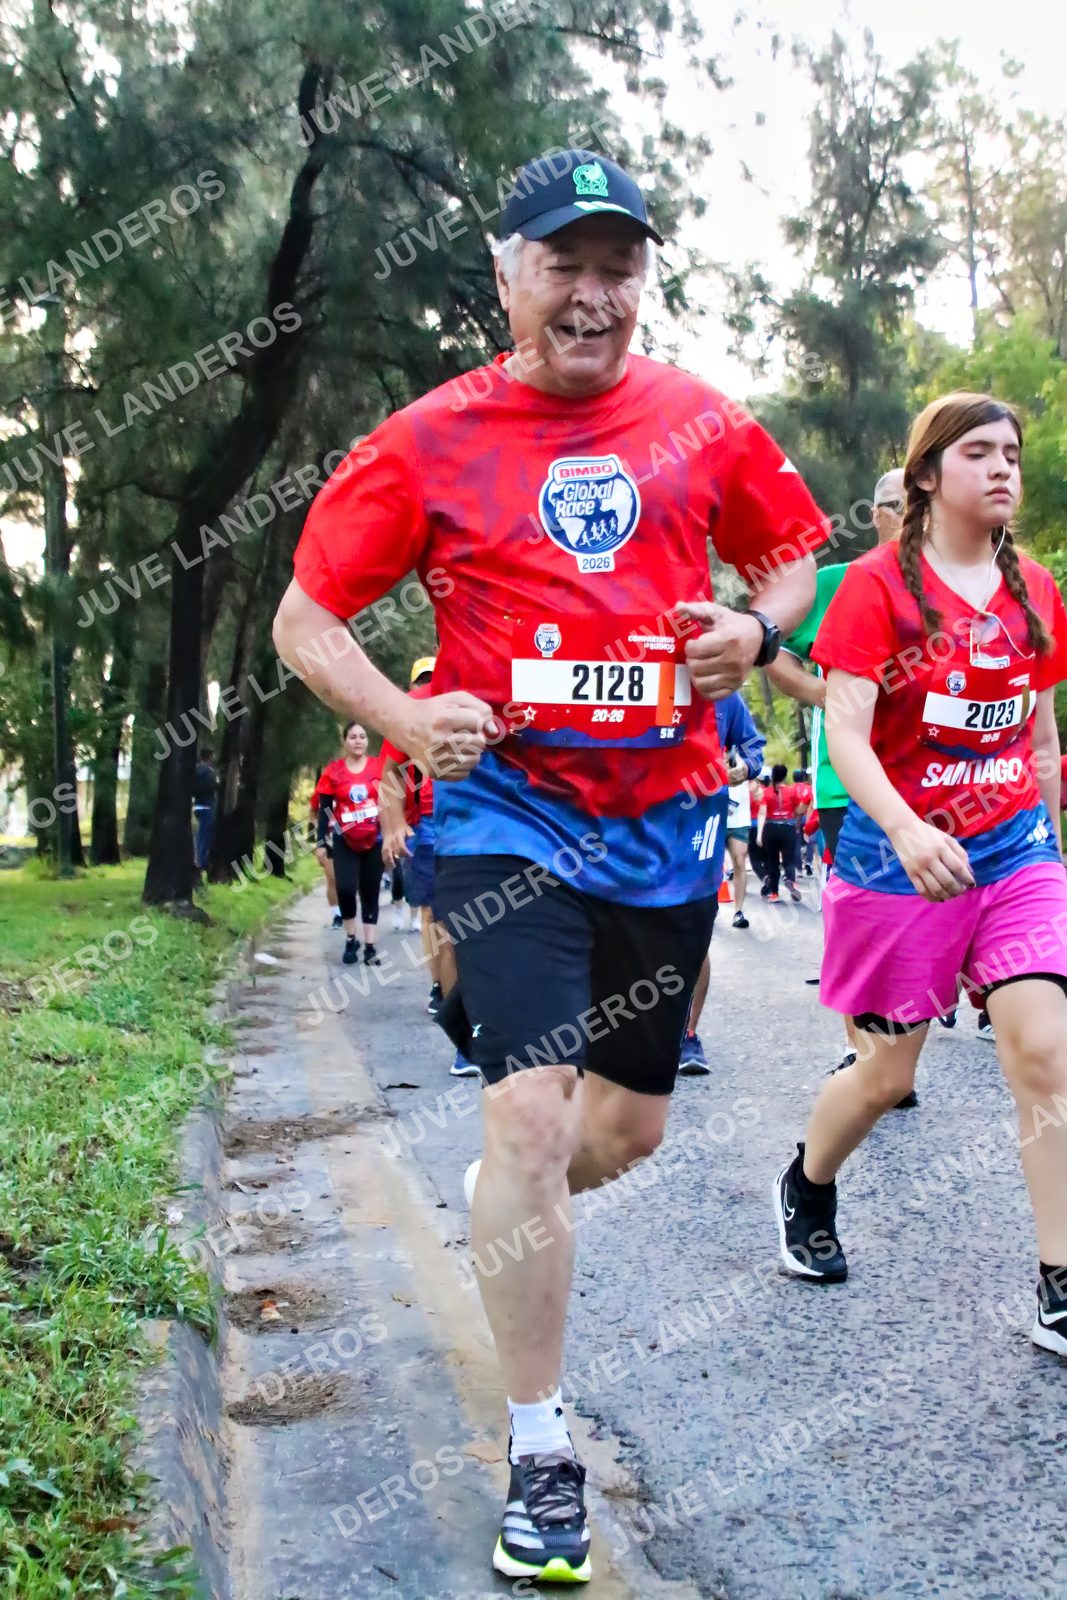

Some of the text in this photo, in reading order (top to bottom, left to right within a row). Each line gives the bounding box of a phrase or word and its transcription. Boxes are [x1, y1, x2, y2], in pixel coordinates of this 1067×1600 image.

[559, 464, 613, 479] BIMBO
[563, 480, 614, 501] Global
[555, 500, 596, 518] Race
[582, 556, 610, 570] 2026
[571, 663, 644, 702] 2128
[965, 699, 1015, 729] 2023
[660, 727, 675, 739] 5K
